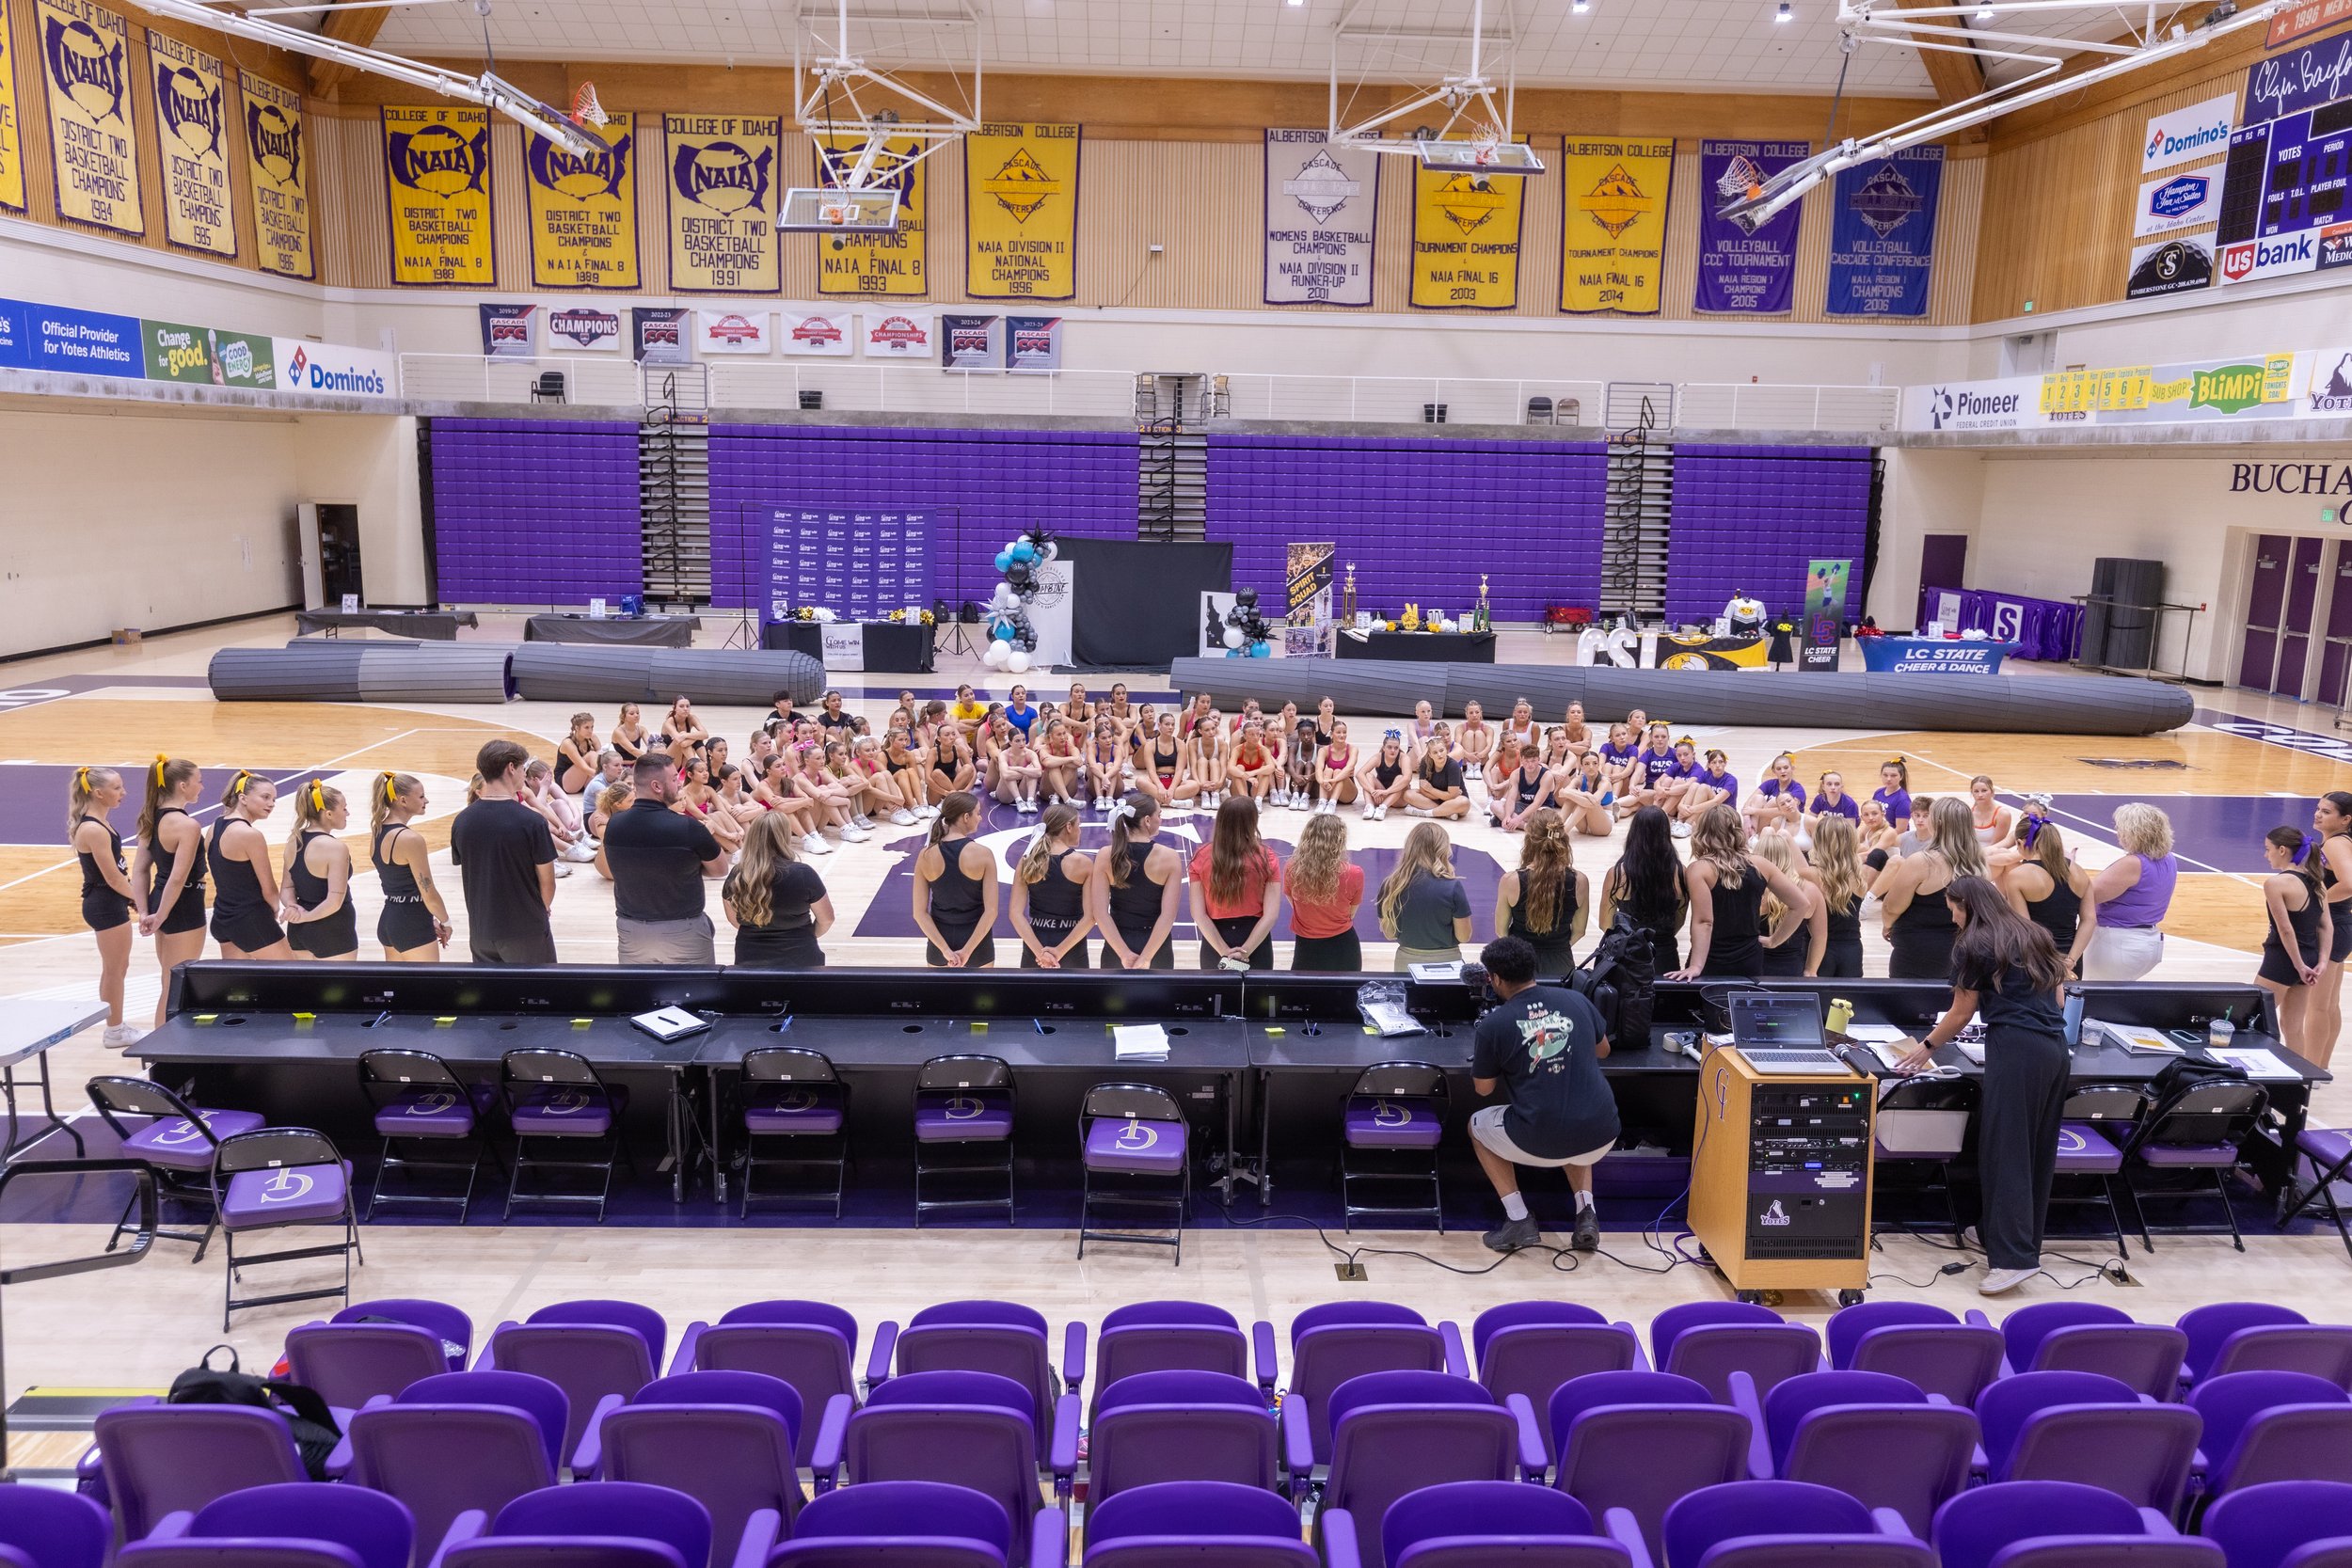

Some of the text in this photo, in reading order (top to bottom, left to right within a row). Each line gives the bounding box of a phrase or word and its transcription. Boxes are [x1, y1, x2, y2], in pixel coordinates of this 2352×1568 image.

[81, 1, 124, 37] OF IDAHO
[2295, 5, 2320, 30] 1996
[151, 31, 221, 78] COLLEGE IDAHO
[61, 40, 115, 98] NAIA
[241, 72, 271, 102] COLLEGE
[171, 87, 213, 135] NAIA
[385, 109, 485, 123] COLLEGE OF IDAHO
[667, 119, 778, 136] COLLEGE OF IDAHO
[970, 124, 1075, 138] ALBERTSON COLLEGE
[60, 118, 127, 158] DISTRICT TWO
[258, 121, 292, 162] NAIA
[1269, 131, 1327, 143] ALBERTSON
[2164, 120, 2229, 155] Domino's
[1565, 143, 1673, 158] ALBERTSON COLLEGE
[1703, 144, 1808, 158] ALBERTSON COLLEGE
[1899, 147, 1943, 160] COLLEGE
[2279, 145, 2302, 162] YOTES
[2324, 140, 2344, 153] PERIOD
[65, 142, 129, 181] BASKETBALL
[408, 148, 473, 179] NAIA
[549, 150, 611, 182] NAIA
[171, 154, 223, 188] DISTRICT TWO
[693, 160, 755, 194] NAIA
[72, 168, 125, 201] CHAMPIONS
[173, 176, 224, 208] BASKETBALL
[2160, 183, 2199, 198] Hampton
[258, 186, 305, 214] DISTRICT TWO
[2267, 182, 2332, 203] FOULS PLAYER
[91, 198, 112, 222] 1984
[180, 199, 221, 227] CHAMPIONS
[405, 207, 477, 220] DISTRICT TWO
[546, 210, 621, 222] DISTRICT TWO
[261, 207, 306, 233] BASKETBALL
[409, 221, 473, 232] BASKETBALL
[681, 217, 767, 236] DISTRICT TWO
[2167, 214, 2205, 228] Idaho Center
[2265, 214, 2333, 235] WON MATCH
[194, 225, 211, 246] 1985
[548, 223, 619, 235] BASKETBALL
[1269, 230, 1371, 243] WOMENS BASKETBALL
[265, 229, 302, 252] CHAMPIONS
[416, 234, 469, 245] CHAMPIONS
[558, 236, 612, 247] CHAMPIONS
[685, 236, 765, 253] BASKETBALL
[978, 241, 1052, 253] NAIA DIVISION
[1717, 241, 1780, 253] VOLLEYBALL
[1293, 243, 1346, 256] CHAMPIONS
[1415, 242, 1518, 255] TOURNAMENT CHAMPIONS
[1568, 247, 1659, 258] TOURNAMENT CHAMPIONS
[1852, 241, 1912, 254] VOLLEYBALL
[2256, 234, 2312, 267] bank
[405, 257, 467, 268] NAIA FINAL
[548, 260, 613, 271] NAIA FINAL
[691, 252, 759, 270] CHAMPIONS
[825, 260, 920, 275] NAIA FINAL 8
[995, 256, 1045, 268] NATIONAL
[1704, 254, 1790, 267] CCC TOURNAMENT
[1831, 253, 1931, 267] CASCADE CONFERENCE
[992, 269, 1050, 281] CHAMPIONS
[1279, 262, 1346, 276] NAIA DIVISION
[712, 270, 740, 286] 1991
[858, 276, 886, 291] 1993
[1292, 276, 1345, 288] RUNNER-UP
[1431, 271, 1485, 283] NAIA FINAL
[1580, 273, 1631, 287] NAIA FINAL
[1719, 275, 1767, 284] NAIA REGION
[1851, 275, 1900, 285] NAIA REGION
[1009, 282, 1033, 293] 1996
[1308, 287, 1329, 300] 2001
[1450, 289, 1476, 300] 2003
[1724, 284, 1766, 294] CHAMPIONS
[1852, 286, 1903, 298] CHAMPIONS
[2130, 284, 2167, 295] TIMBERSTONE
[1731, 295, 1757, 308] 2005
[1864, 299, 1889, 311] 2006
[41, 320, 119, 343] Official Provider
[551, 319, 617, 334] CHAMPIONS
[157, 328, 191, 350] Change
[954, 338, 987, 347] CCC
[1018, 339, 1050, 348] CCC
[43, 340, 130, 362] for Yotes Athletics
[158, 340, 208, 376] for good.
[228, 345, 246, 360] GOOD
[228, 356, 251, 372] ENERGY
[310, 364, 384, 394] Domino's
[2265, 381, 2287, 389] TONIGHTS
[2153, 382, 2187, 399] SUB SHOP
[2267, 390, 2280, 399] GOAL
[1958, 391, 2019, 415] Pioneer
[1290, 572, 1314, 594] SPIRIT
[1290, 583, 1316, 607] SQUAD
[1998, 607, 2017, 640] S
[1577, 628, 1658, 669] CSI
[1815, 646, 1836, 655] STATE
[1905, 649, 1989, 660] LC STATE
[1895, 663, 1990, 674] CHEER DANCE
[1761, 1215, 1789, 1225] YOTES
